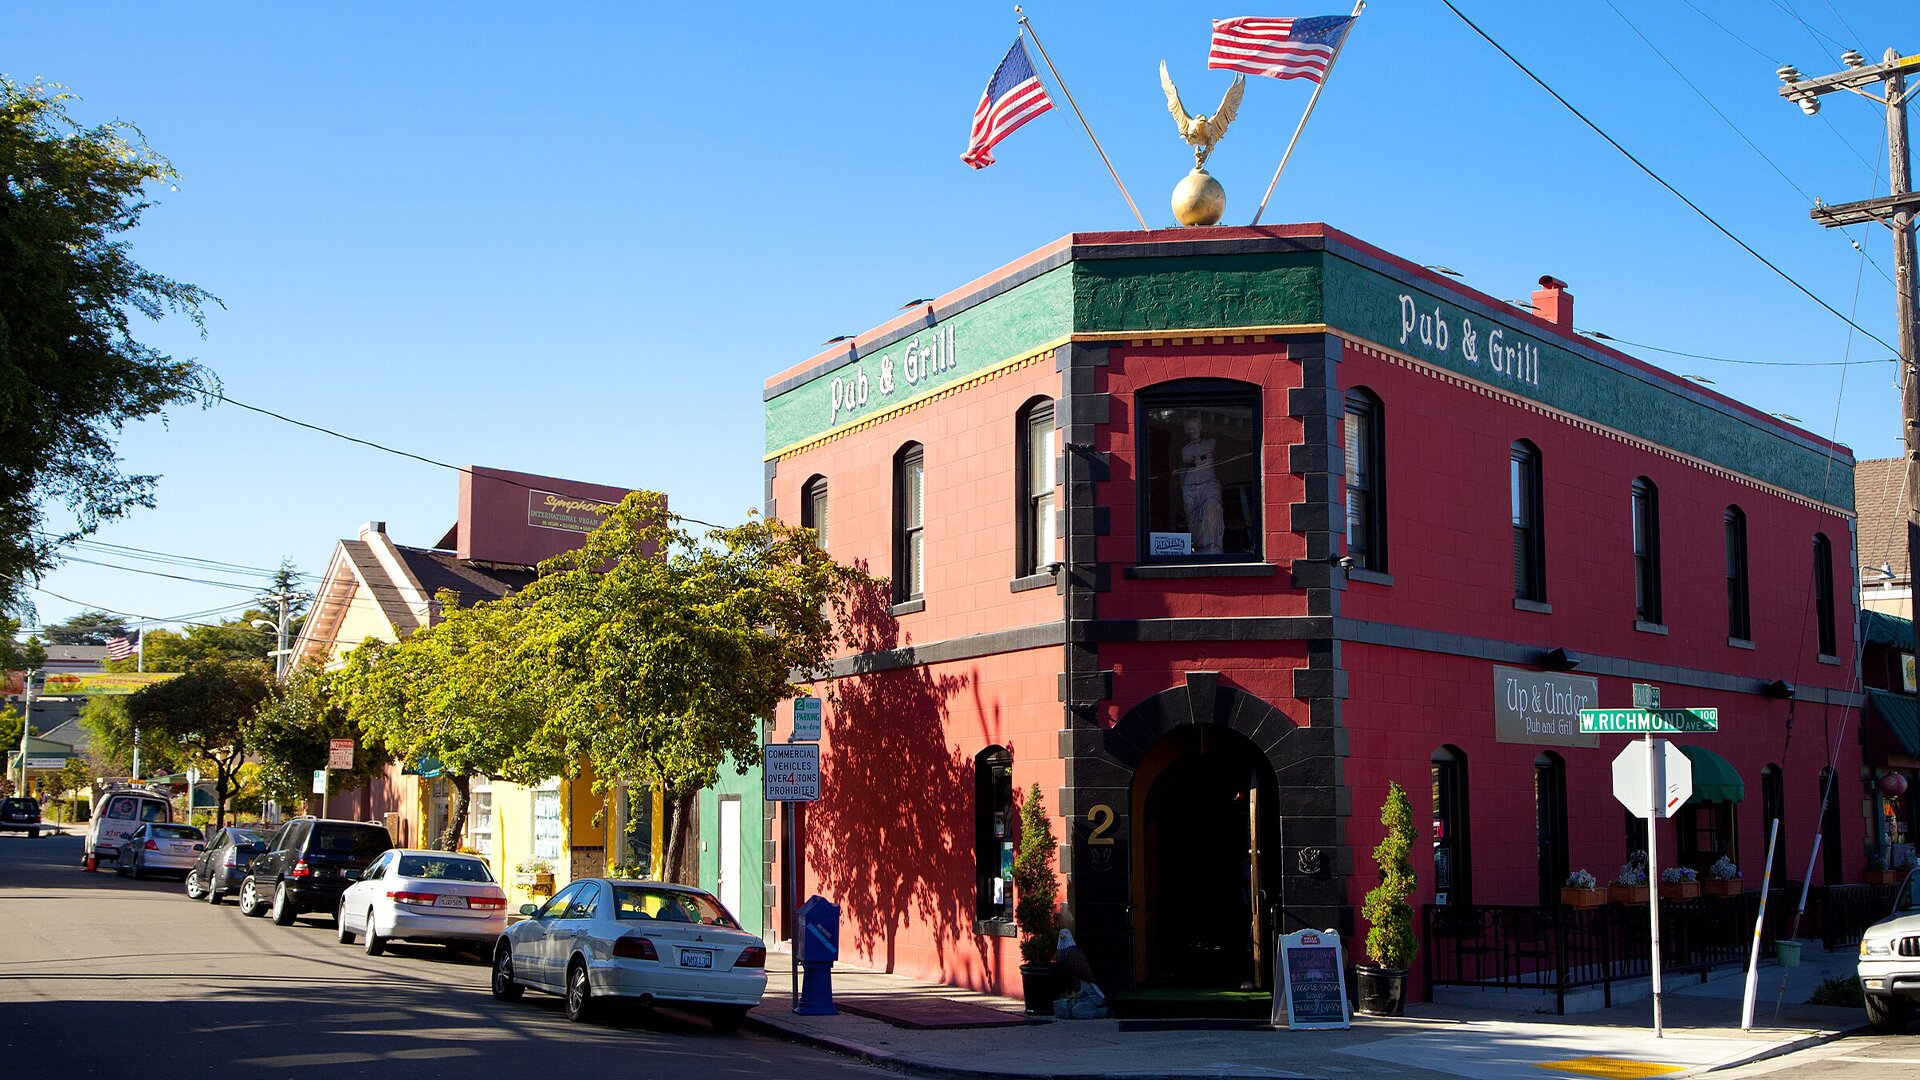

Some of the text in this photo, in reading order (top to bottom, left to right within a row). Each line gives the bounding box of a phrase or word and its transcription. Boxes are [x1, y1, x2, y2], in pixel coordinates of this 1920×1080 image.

[1399, 294, 1539, 385] Pub & Grill
[830, 322, 957, 426] Pub & Grill
[530, 510, 577, 522] INTERNATIONAL
[578, 517, 598, 525] VEGAN
[796, 700, 804, 709] 2
[1507, 678, 1588, 720] Up & Under
[796, 713, 820, 721] PARKING
[1685, 722, 1701, 730] AVE
[1700, 711, 1715, 720] 100
[1526, 717, 1573, 735] Pub and Grill
[768, 750, 816, 759] COMMERCIAL
[773, 762, 812, 771] VEHICLES
[768, 774, 787, 783] OVER
[798, 773, 817, 782] TONS
[770, 786, 815, 795] PROHIBITED
[1087, 804, 1115, 845] 2
